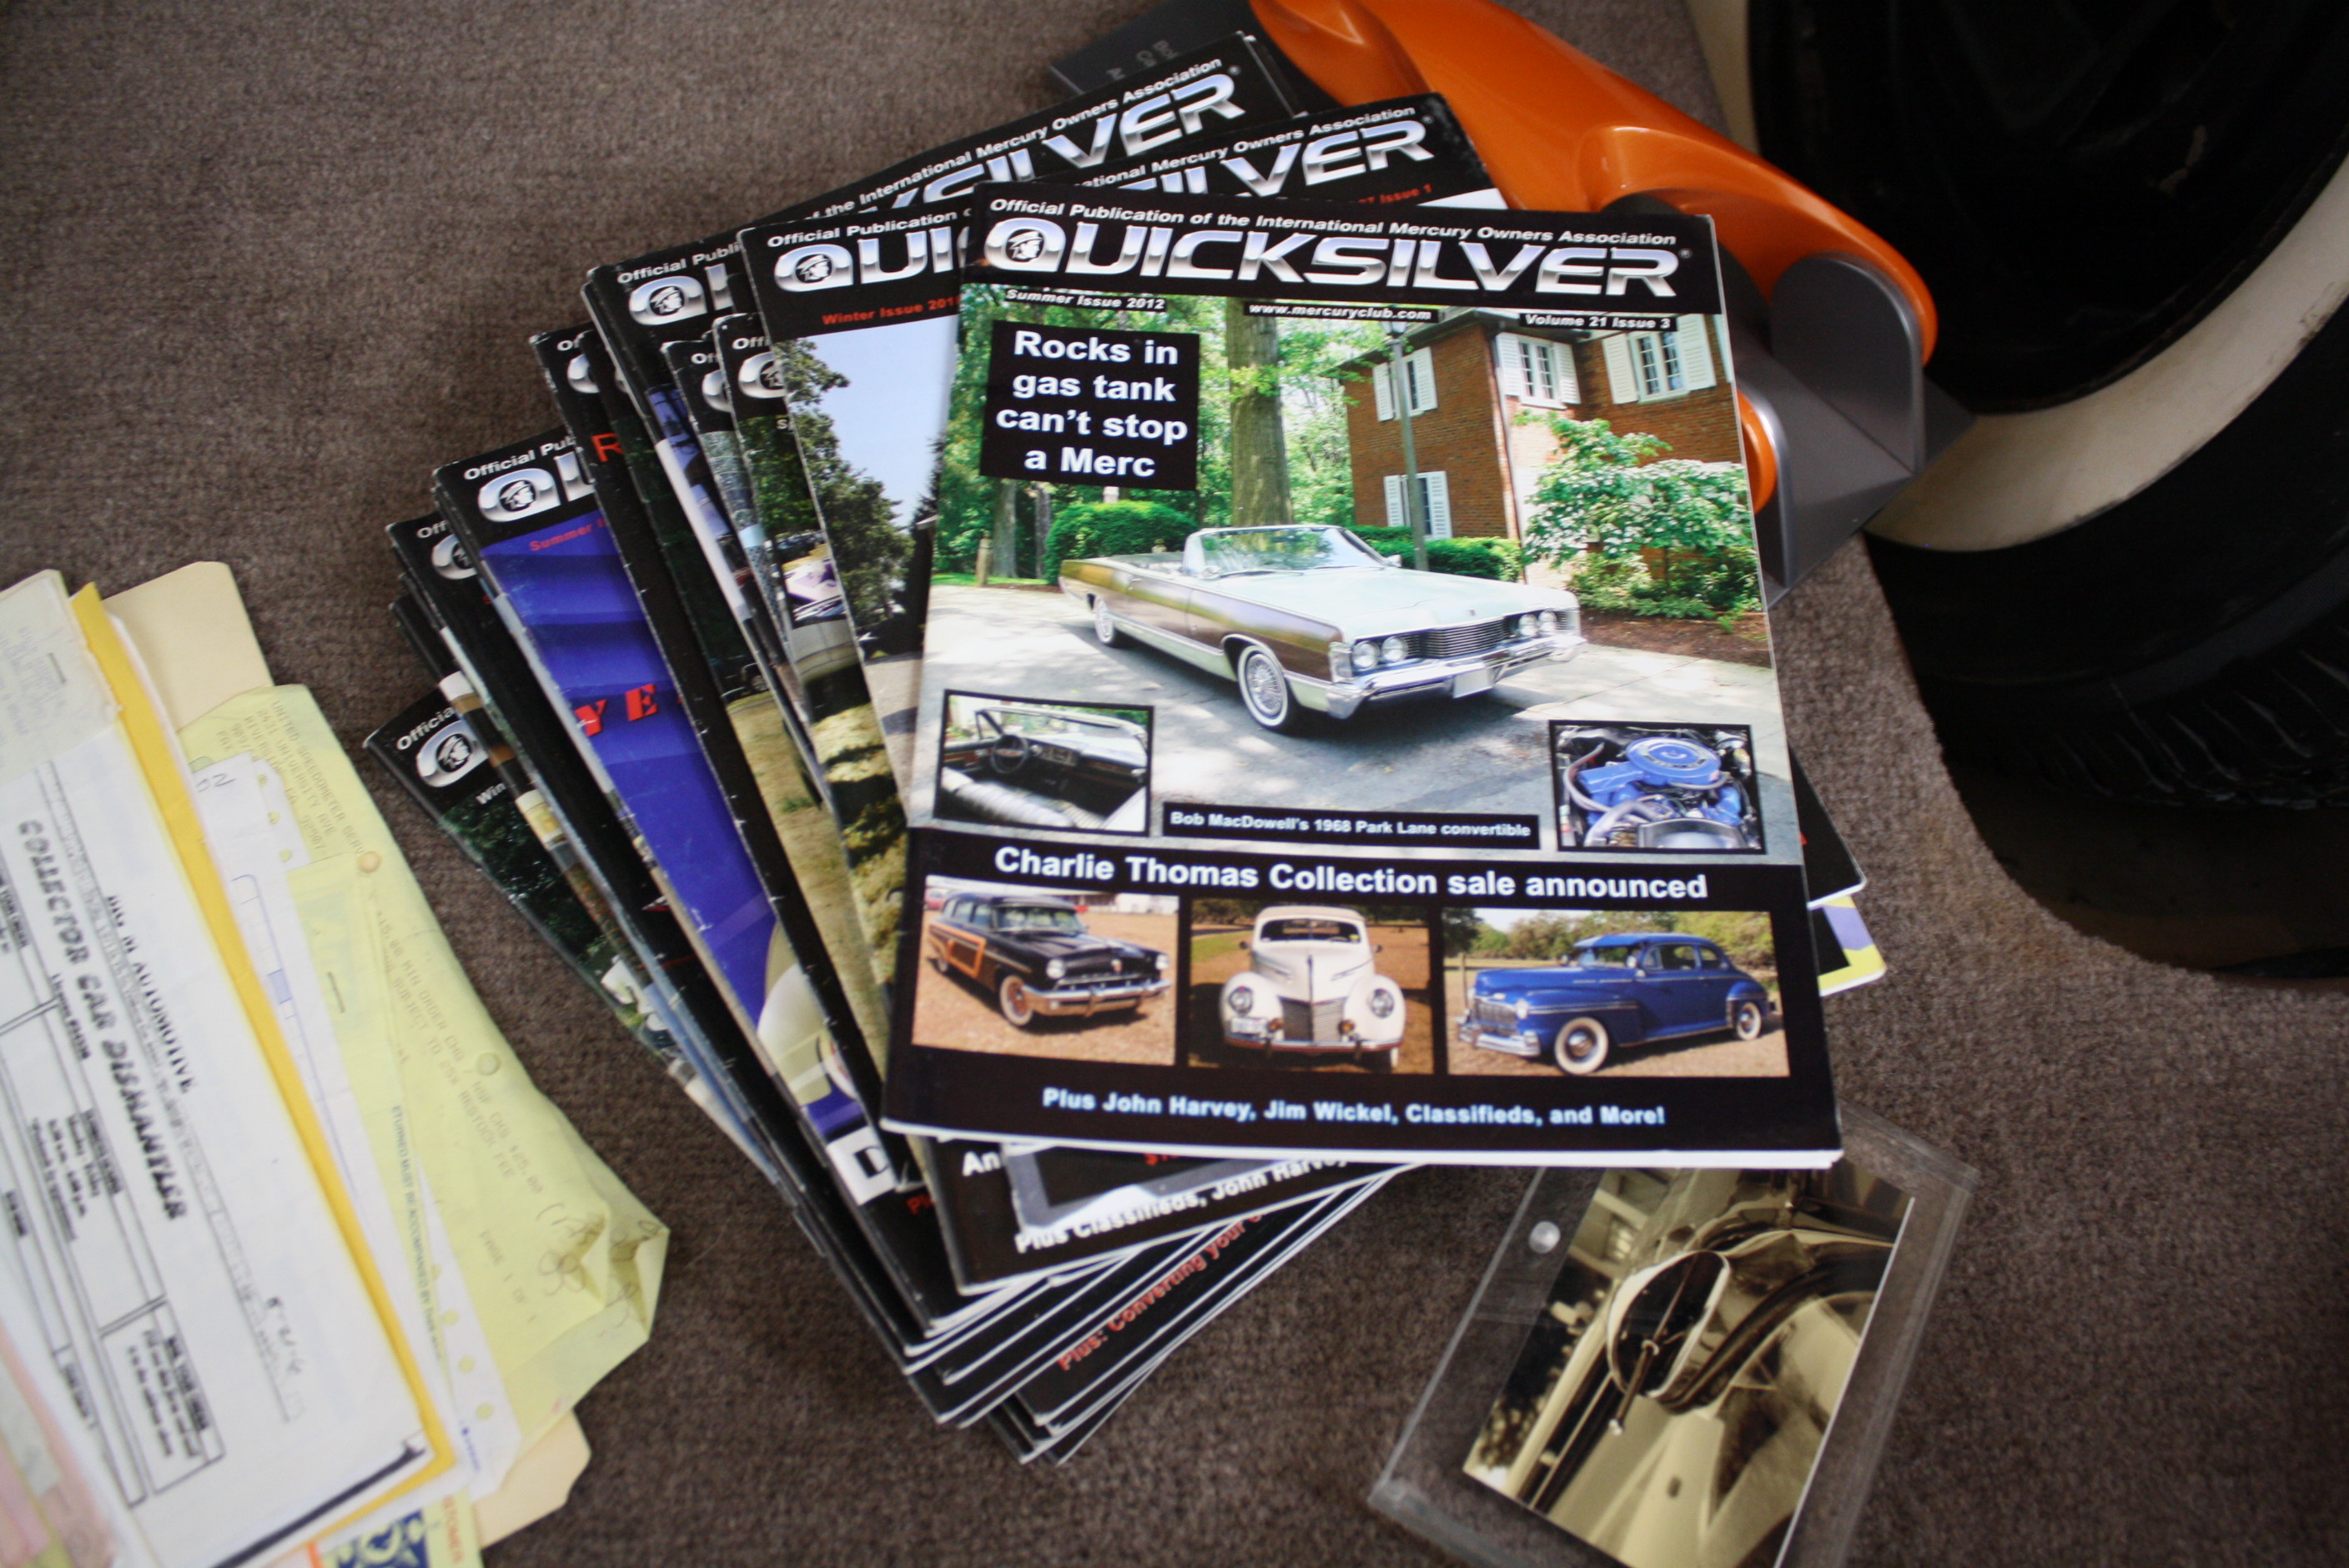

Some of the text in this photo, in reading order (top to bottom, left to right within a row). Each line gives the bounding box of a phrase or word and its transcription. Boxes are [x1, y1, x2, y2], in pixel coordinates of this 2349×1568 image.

[859, 152, 972, 204] International
[975, 126, 1048, 158] Mercury
[1052, 99, 1119, 130] Owners
[1123, 58, 1222, 103] Association
[1152, 147, 1228, 173] Mercury
[1234, 128, 1304, 152] Owners
[1309, 108, 1415, 134] Association
[1380, 188, 1421, 204] Issue
[767, 228, 840, 247] Official
[847, 212, 957, 236] Publication
[990, 199, 1064, 216] Official
[1069, 205, 1184, 224] Publication
[1190, 213, 1212, 225] of
[1217, 214, 1250, 227] the
[1255, 215, 1382, 234] International
[1390, 222, 1471, 239] Mercury
[1477, 227, 1553, 241] Owners
[1557, 230, 1676, 245] Association
[617, 259, 687, 284] Official
[984, 218, 1679, 296] QUICKSILVER
[822, 310, 875, 324] Winter
[880, 304, 923, 318] Issue
[1006, 289, 1165, 309] Summer Issue 2012
[1250, 304, 1431, 320] www.mercuryclub.com
[1526, 314, 1671, 329] Volume 21 Issue 3
[1014, 330, 1178, 364] Rocks in
[1013, 374, 1176, 402] gas tank
[996, 409, 1188, 445] can't stop
[464, 450, 535, 480] Official
[1024, 446, 1155, 477] a Merc
[529, 524, 593, 551] Summer
[269, 699, 300, 741] UNITED
[294, 744, 347, 822] SPEEDOMETER
[274, 738, 321, 808] UNIVERSITY
[1170, 812, 1531, 836] Bob MacDowell's 1968 Park Lane convertible
[995, 847, 1708, 899] Charlie Thomas Collection sale announced
[15, 817, 92, 966] COLLECTOR
[73, 969, 119, 1034] CAR
[98, 1036, 190, 1222] DISMANTLER
[417, 988, 448, 1032] ORDER
[1044, 1088, 1665, 1126] Plus John Harvey, Jim Wickel, Classifieds, and More!
[1015, 1225, 1069, 1254] Plus
[1212, 1171, 1268, 1201] John
[1058, 1220, 1246, 1371] Plus: Converting your
